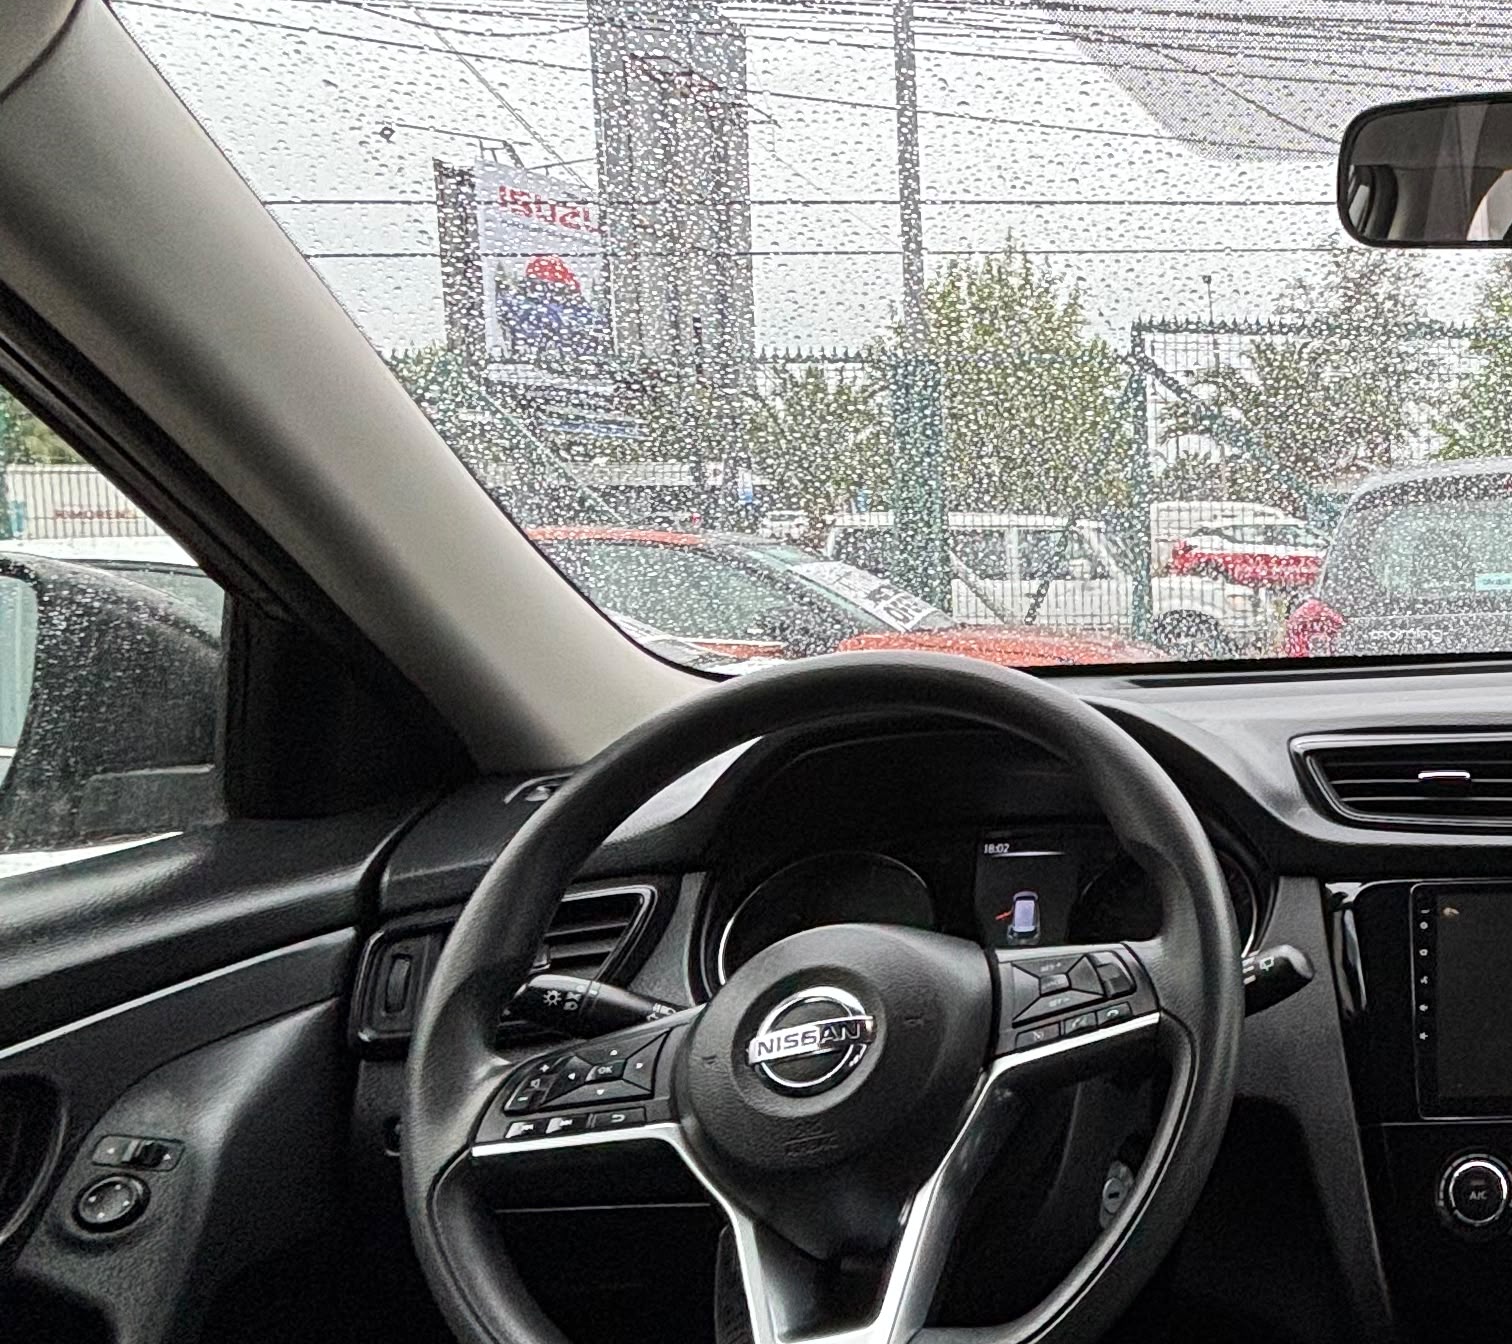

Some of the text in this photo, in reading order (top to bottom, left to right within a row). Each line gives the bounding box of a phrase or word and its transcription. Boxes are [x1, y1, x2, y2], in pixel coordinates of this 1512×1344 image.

[1369, 628, 1444, 644] morning
[757, 1020, 862, 1056] NISSAN
[597, 1066, 614, 1075] OK
[1469, 1190, 1488, 1201] A/C
